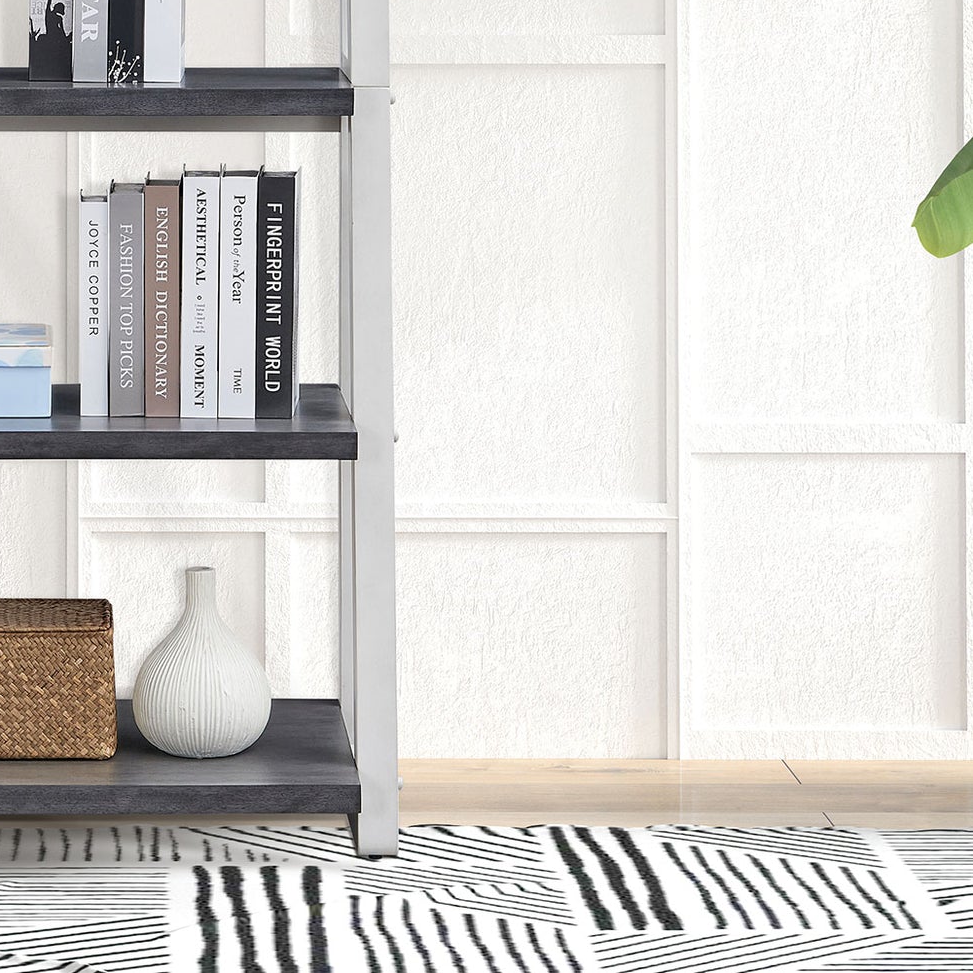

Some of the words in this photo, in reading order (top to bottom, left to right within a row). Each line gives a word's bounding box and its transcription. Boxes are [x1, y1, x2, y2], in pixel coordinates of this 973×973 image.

[88, 220, 99, 268] JOYCE
[155, 207, 169, 283] ENGLISH
[194, 188, 207, 286] AESTHETICAL
[233, 194, 246, 247] Person
[120, 224, 133, 298] FASHION
[232, 270, 246, 304] Year
[265, 203, 283, 325] FINGERPRINT
[88, 276, 99, 336] COPPER
[119, 301, 132, 337] TOP
[119, 340, 133, 389] PICKS
[155, 291, 169, 399] DICTIONARY
[264, 336, 282, 393] WORLD
[194, 344, 206, 409] MOMENT
[234, 368, 243, 394] TIME
